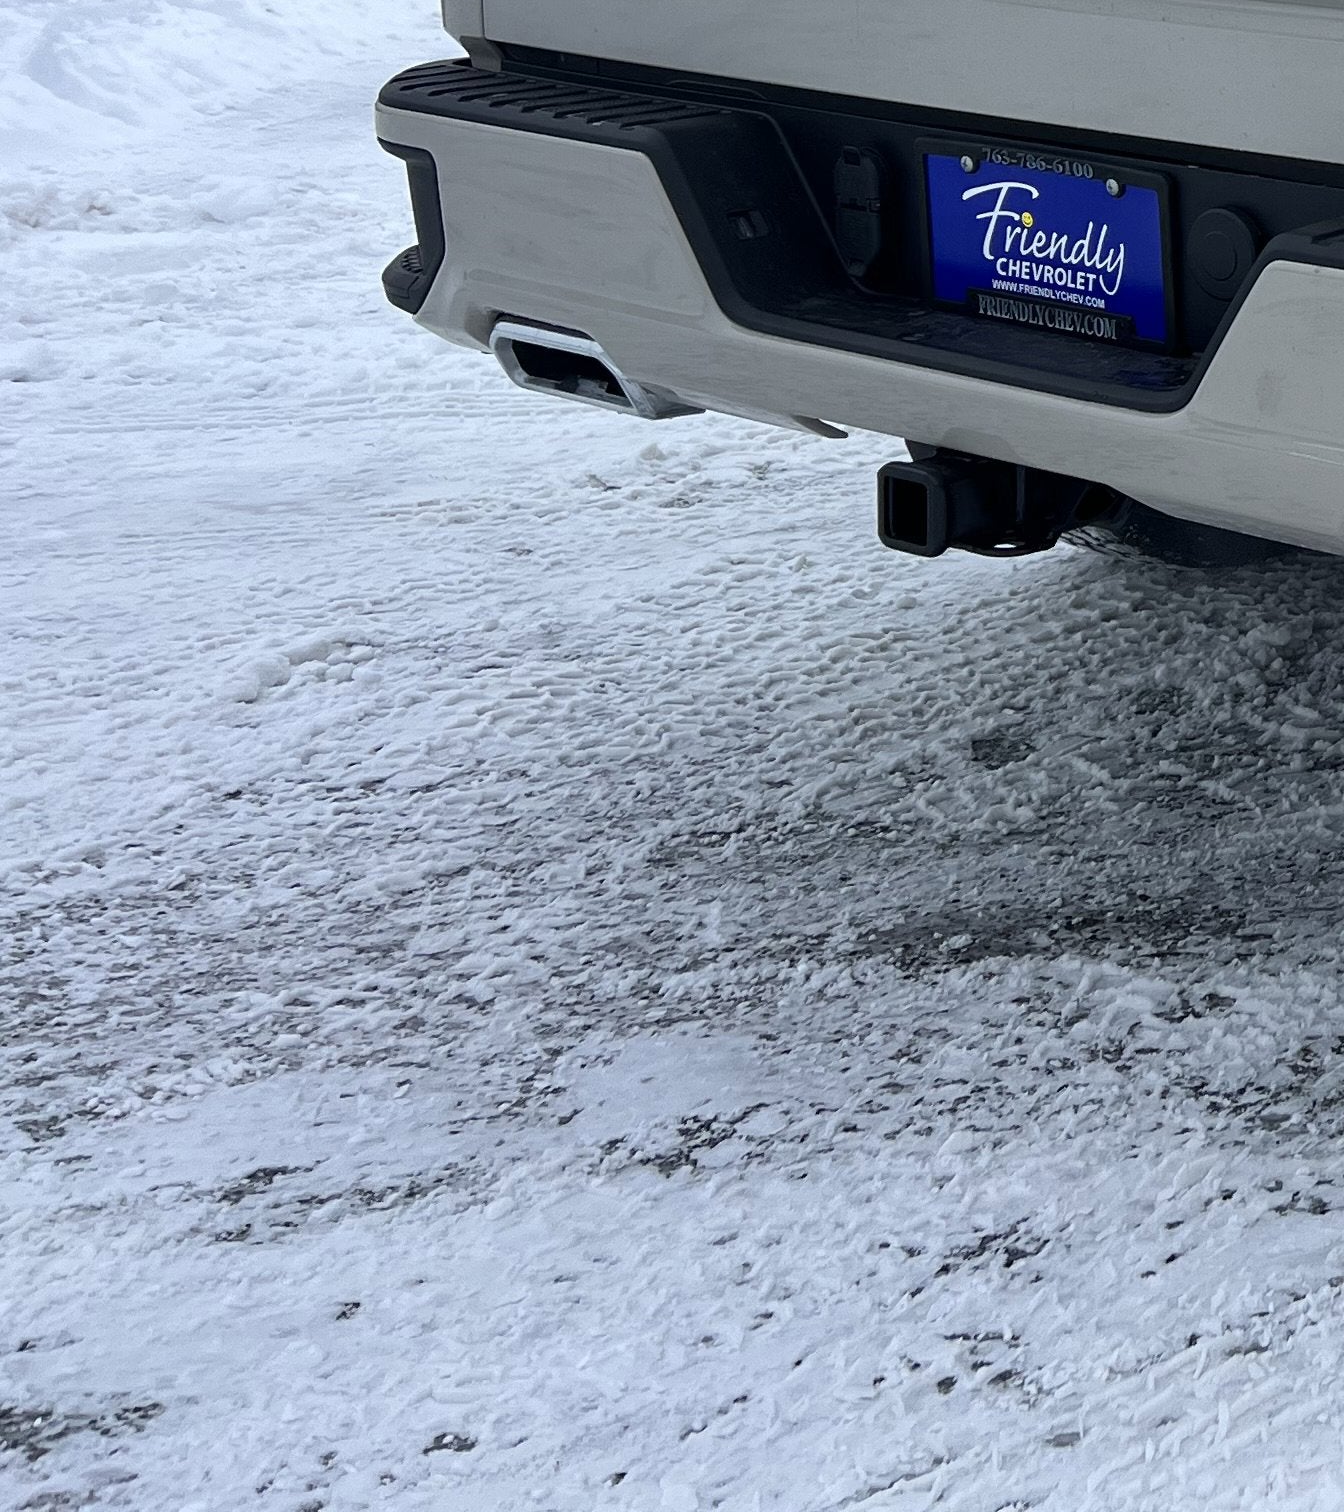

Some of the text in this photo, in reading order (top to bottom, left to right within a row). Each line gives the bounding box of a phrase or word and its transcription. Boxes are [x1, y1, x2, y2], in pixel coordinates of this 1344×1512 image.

[982, 147, 1094, 178] 763-786-6100
[961, 181, 1124, 296] Friendly
[996, 257, 1097, 292] CHEVROLET
[991, 278, 1106, 310] WWW.FRIENDLYCHEV.COM
[977, 294, 1117, 340] FRIENDLYCHEV.COM
